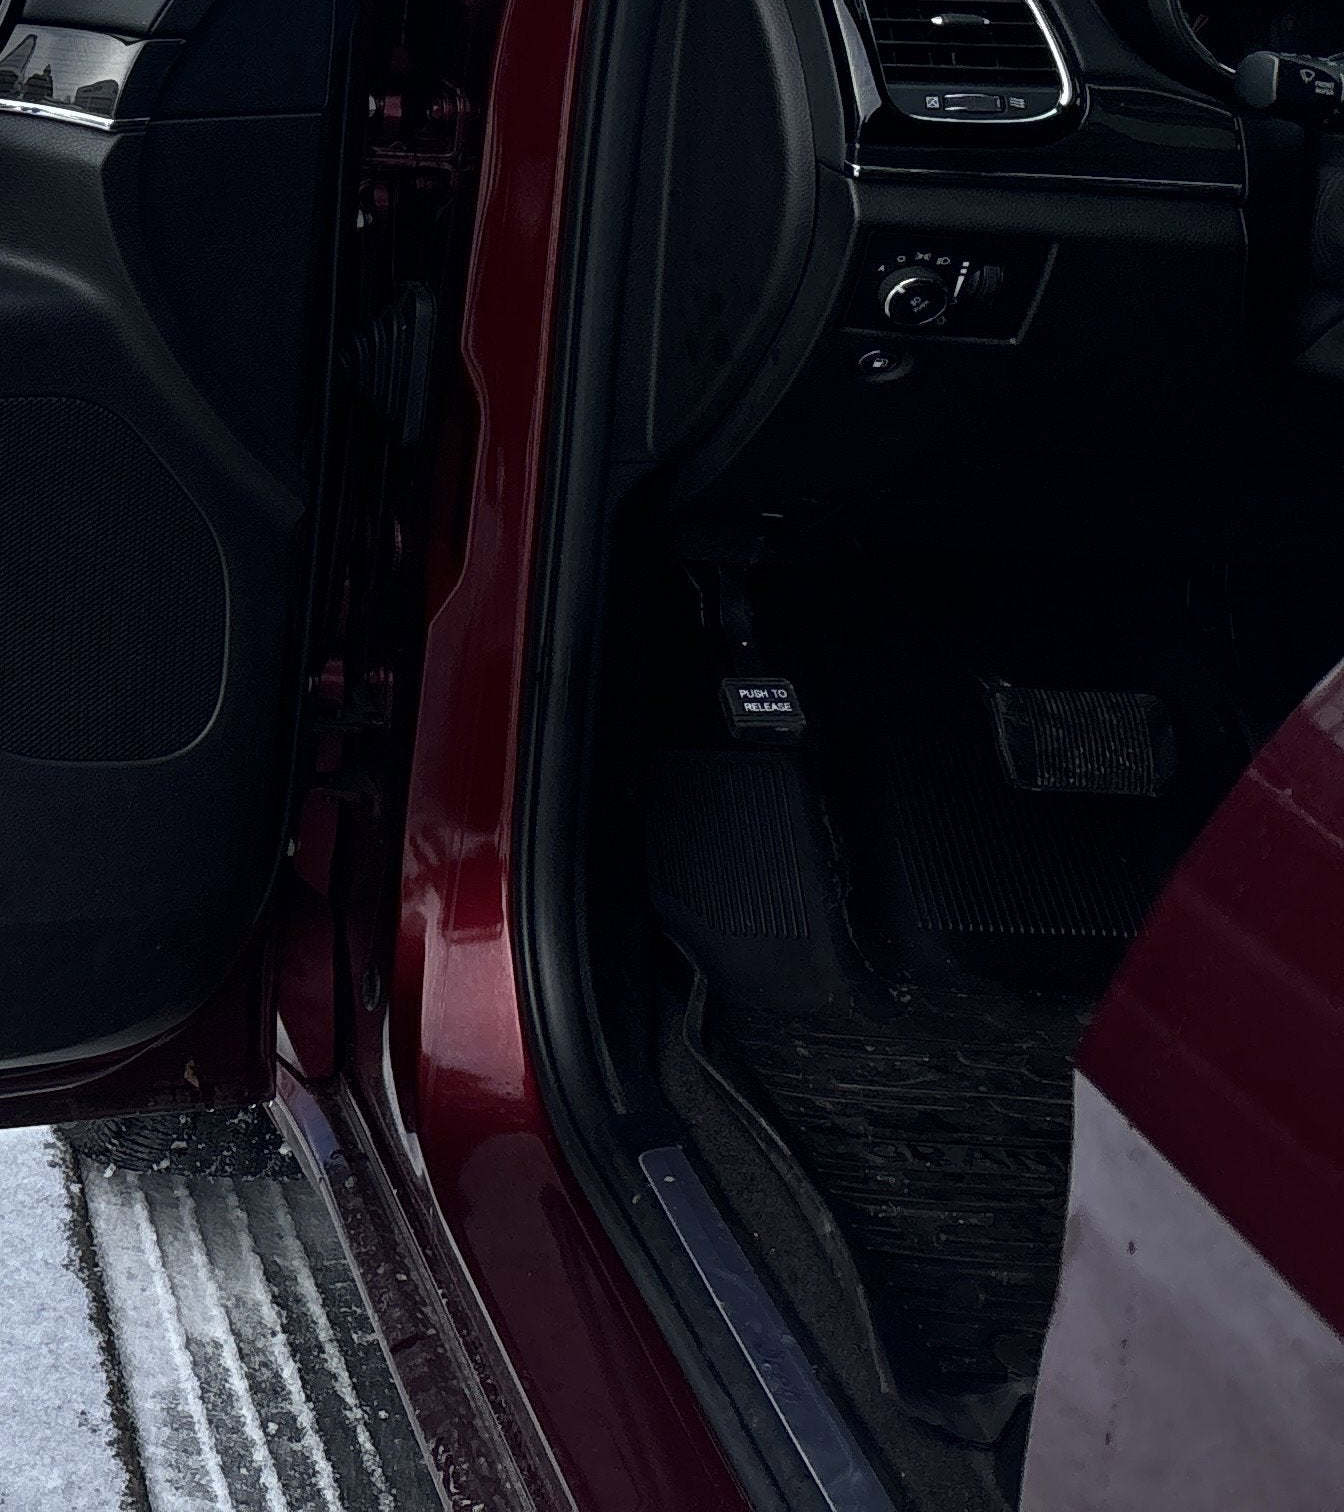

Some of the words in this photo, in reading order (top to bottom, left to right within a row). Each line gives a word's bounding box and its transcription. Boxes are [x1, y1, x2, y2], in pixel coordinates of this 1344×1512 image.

[739, 689, 769, 699] PUSH
[771, 689, 788, 699] TO
[744, 702, 792, 712] RELEASE
